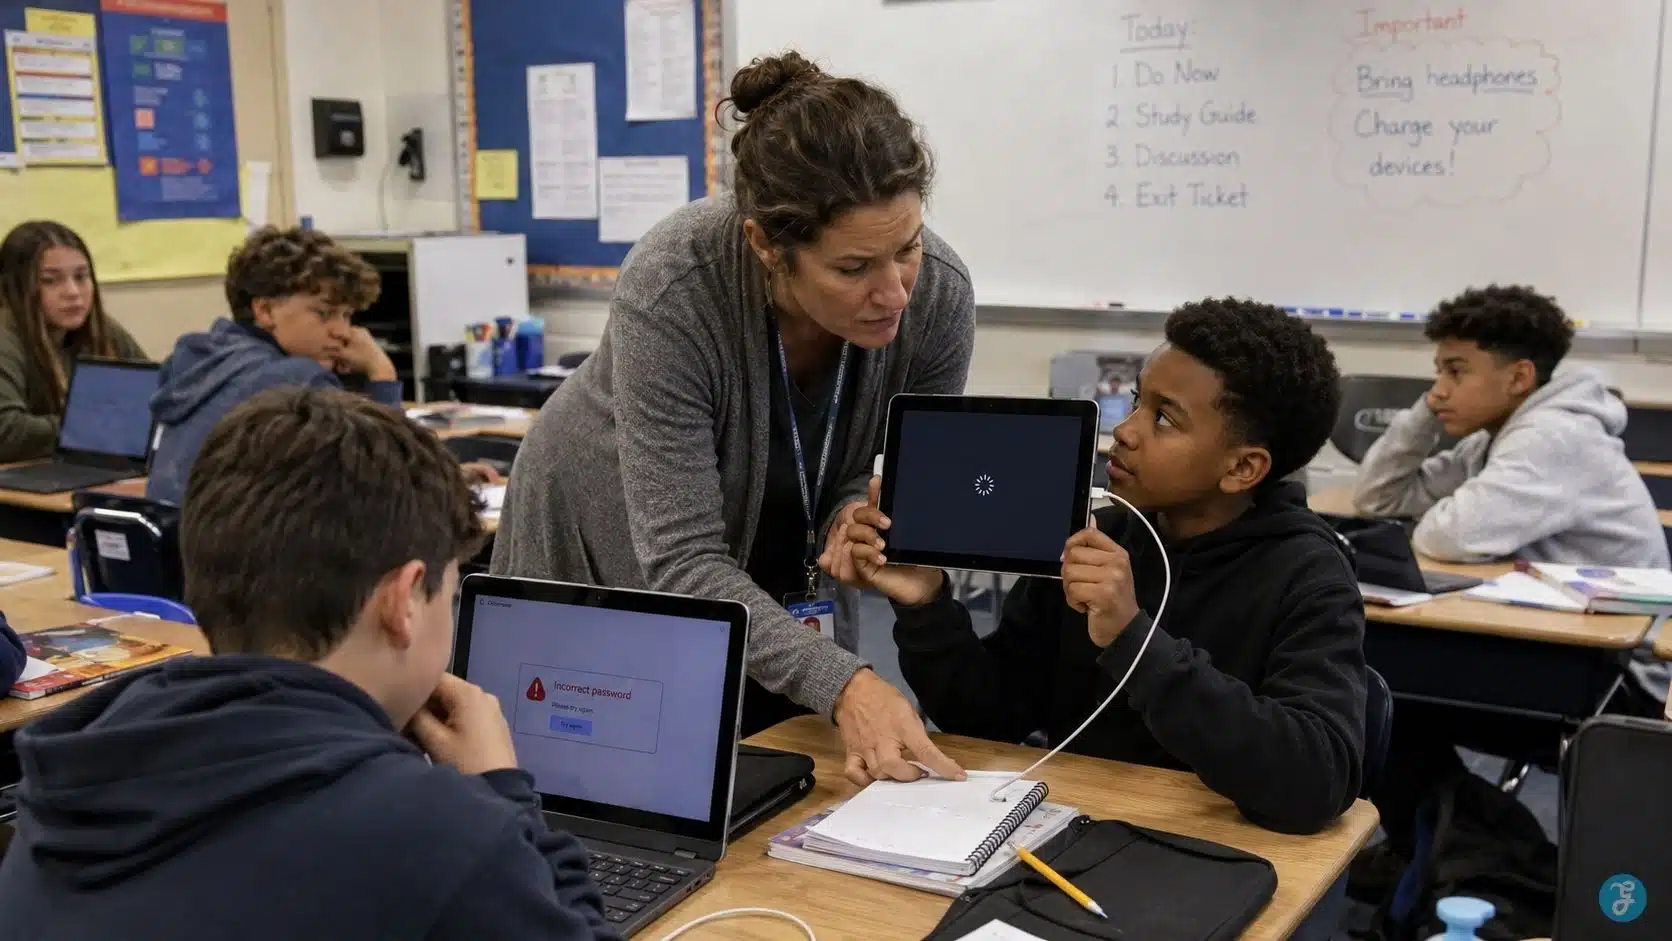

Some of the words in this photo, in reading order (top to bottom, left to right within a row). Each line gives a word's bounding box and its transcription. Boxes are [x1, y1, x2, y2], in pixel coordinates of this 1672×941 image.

[1356, 7, 1468, 43] Important
[1134, 60, 1164, 88] Do
[1174, 58, 1220, 84] Now
[1356, 64, 1415, 103] Bring
[1426, 63, 1538, 96] headphones
[1135, 101, 1192, 136] Study
[1199, 100, 1257, 126] Guide
[1354, 108, 1433, 148] Charge
[1448, 118, 1500, 146] your
[1135, 143, 1240, 168] Discussion
[1369, 148, 1455, 177] devices!
[1136, 181, 1178, 208] Exit
[1186, 181, 1249, 208] Ticket
[553, 681, 590, 695] Incorrect
[592, 687, 632, 701] password
